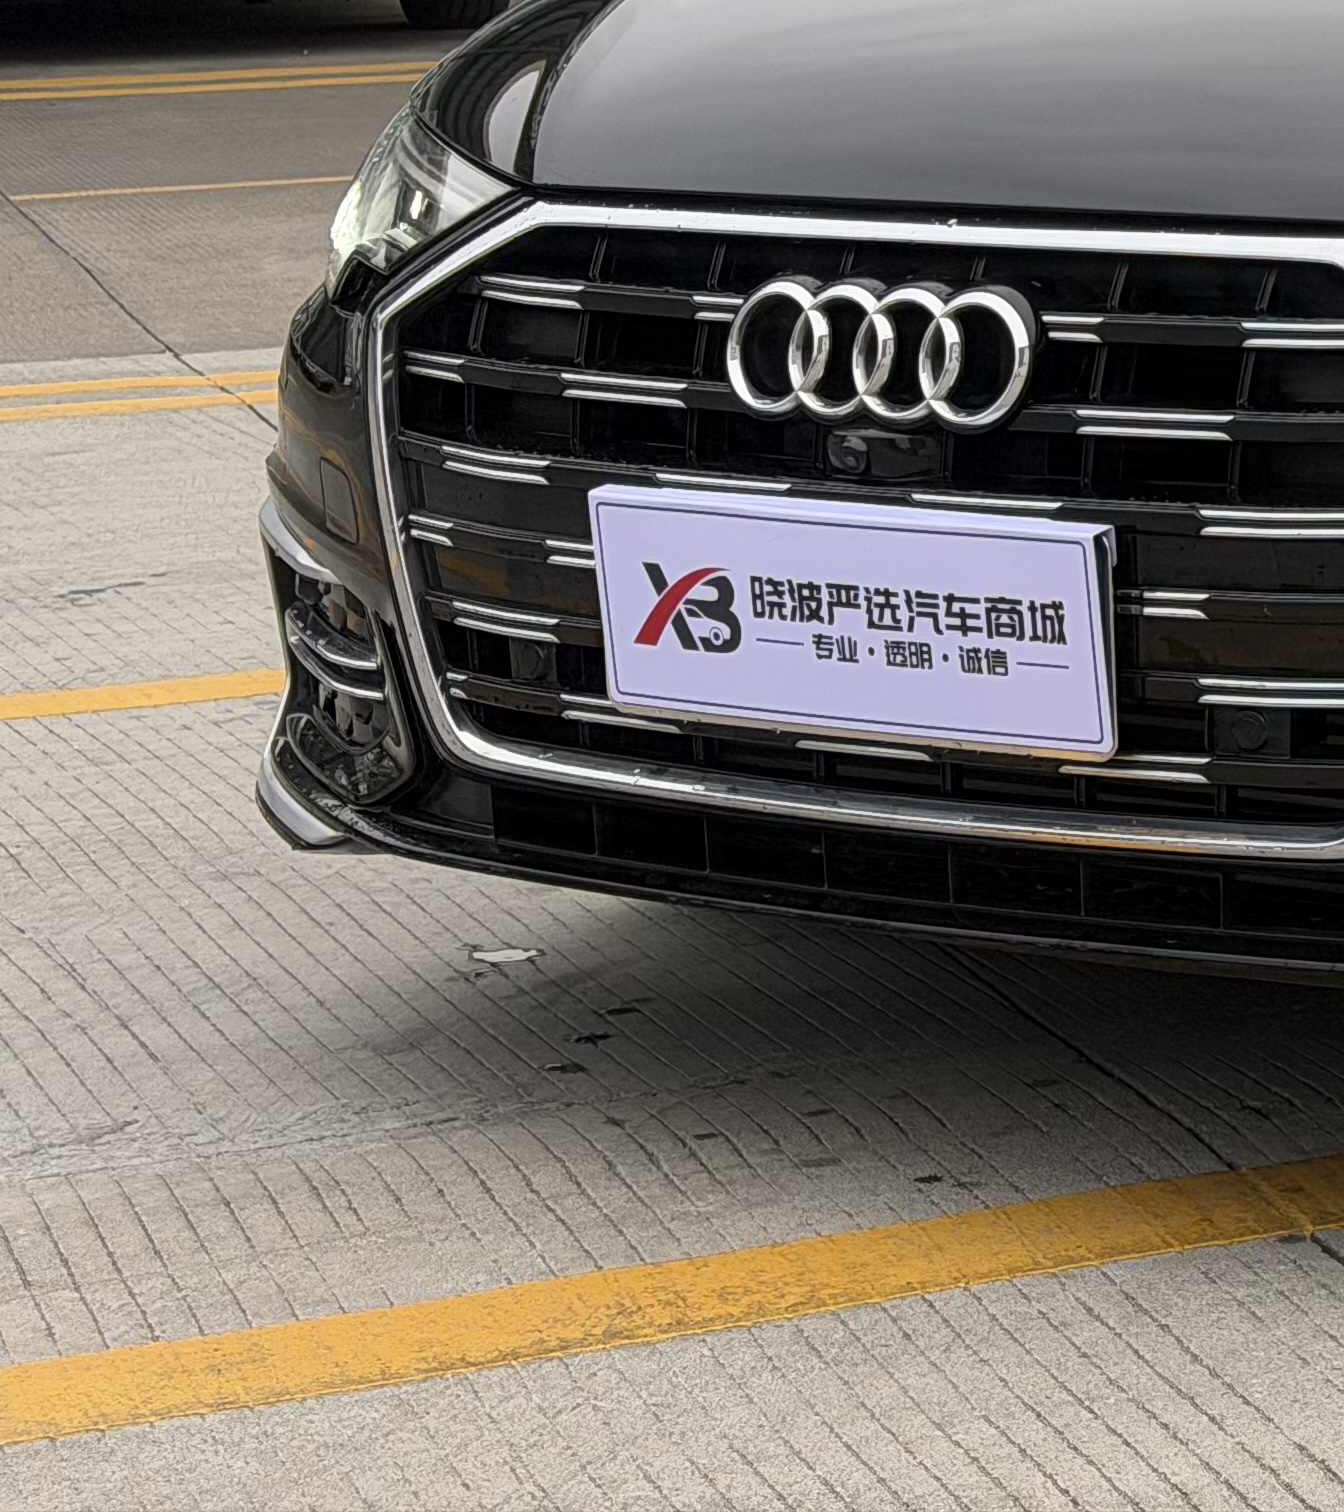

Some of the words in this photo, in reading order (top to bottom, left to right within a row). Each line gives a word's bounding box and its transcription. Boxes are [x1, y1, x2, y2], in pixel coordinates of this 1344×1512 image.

[749, 574, 1069, 646] 晓波严选汽车商城
